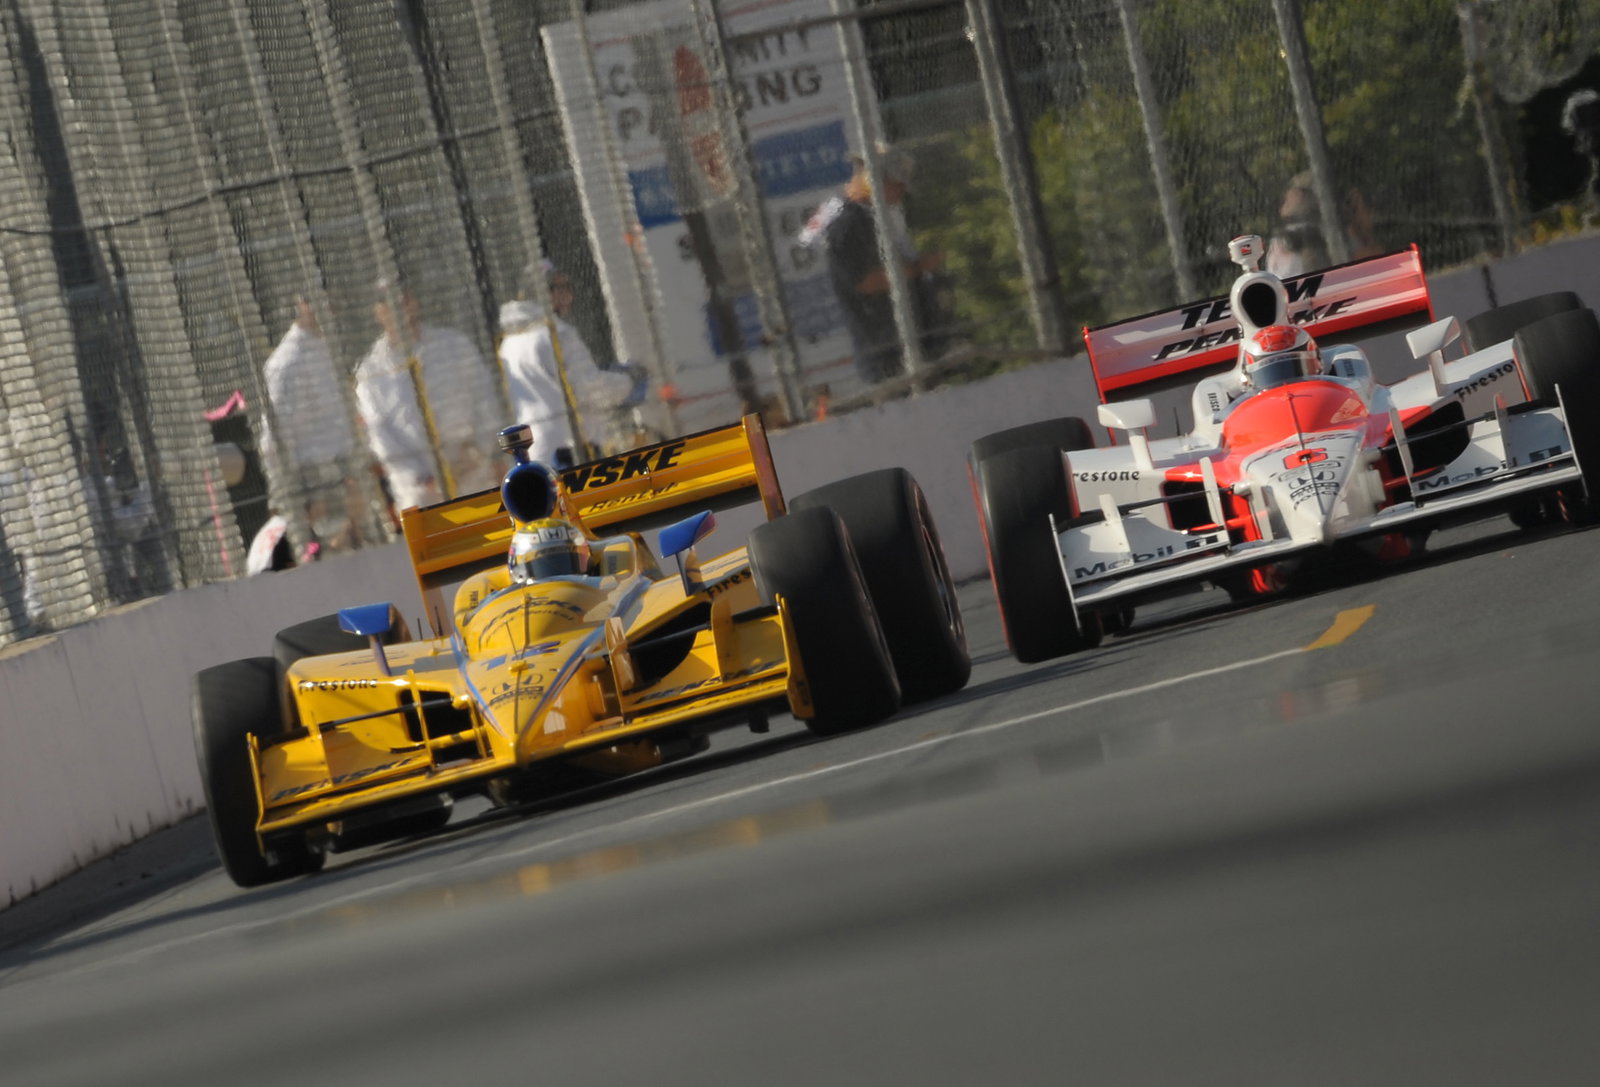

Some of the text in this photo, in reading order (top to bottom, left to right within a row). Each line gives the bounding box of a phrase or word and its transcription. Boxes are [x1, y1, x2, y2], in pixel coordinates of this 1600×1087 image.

[1182, 274, 1324, 331] TEM
[1153, 296, 1357, 361] PENKE
[1453, 359, 1516, 402] Firesto
[561, 441, 686, 494] NSKE
[1417, 456, 1518, 491] Mobil
[1074, 545, 1174, 578] Mobil
